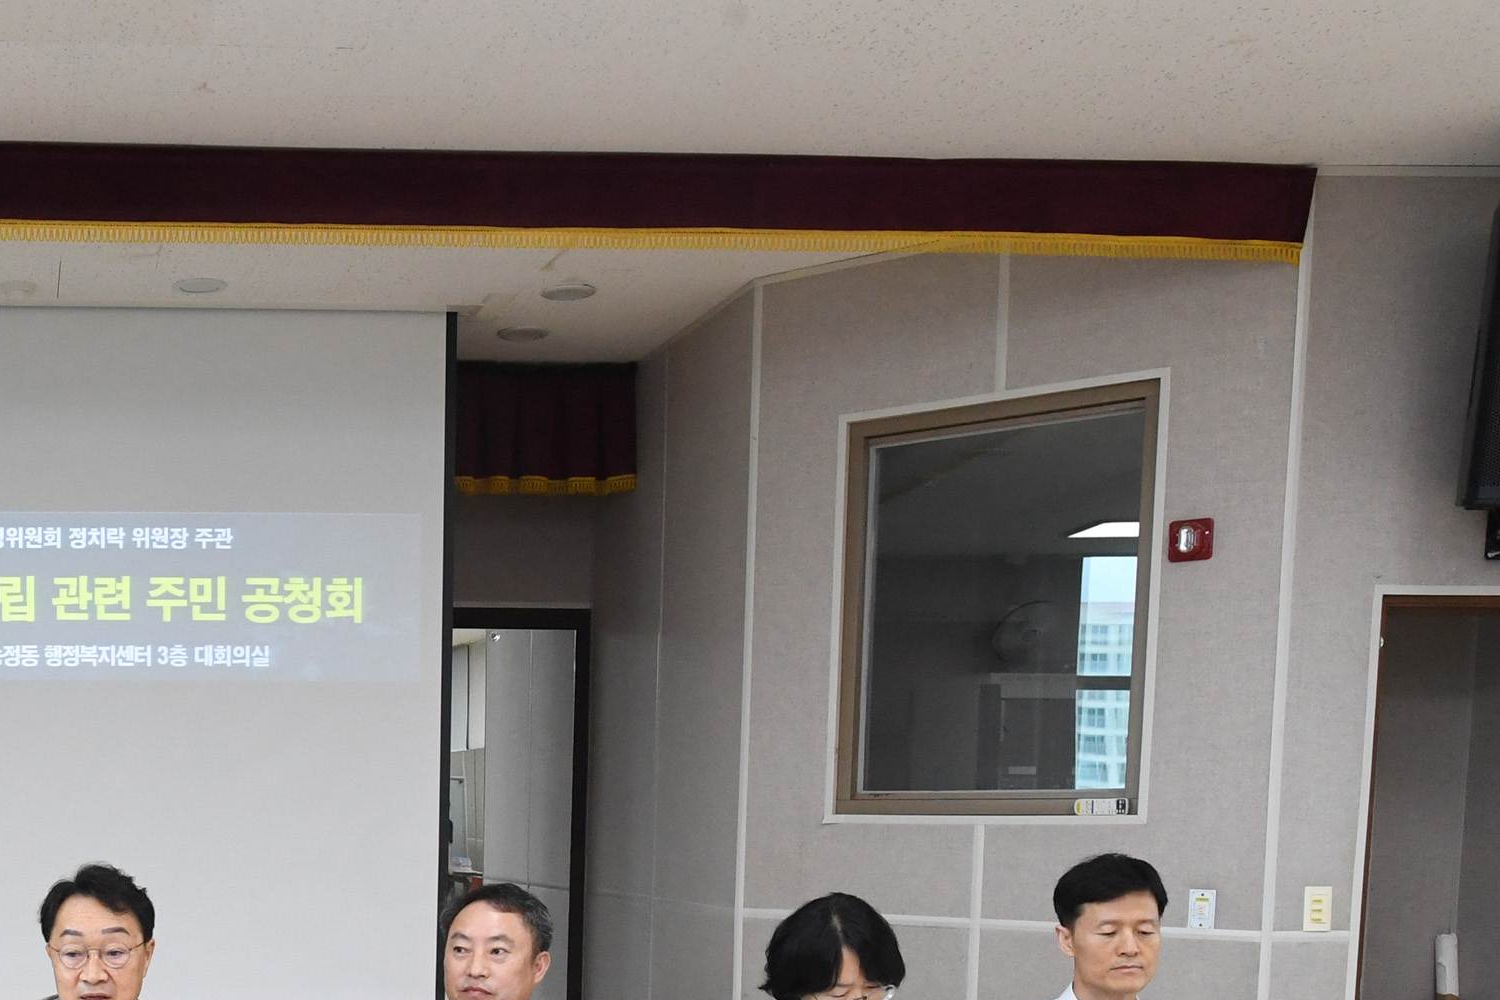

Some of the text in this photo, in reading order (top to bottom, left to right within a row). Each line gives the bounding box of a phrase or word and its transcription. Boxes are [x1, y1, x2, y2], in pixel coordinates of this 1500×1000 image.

[68, 527, 126, 550] 정치락
[132, 527, 189, 550] 위원장
[194, 527, 234, 550] 주관
[51, 575, 132, 621] 관련
[146, 575, 227, 622] 주민
[241, 576, 364, 624] 공청회
[44, 645, 152, 668] 행정복지센터
[157, 645, 189, 667] 3층
[194, 645, 271, 668] 대회의실
